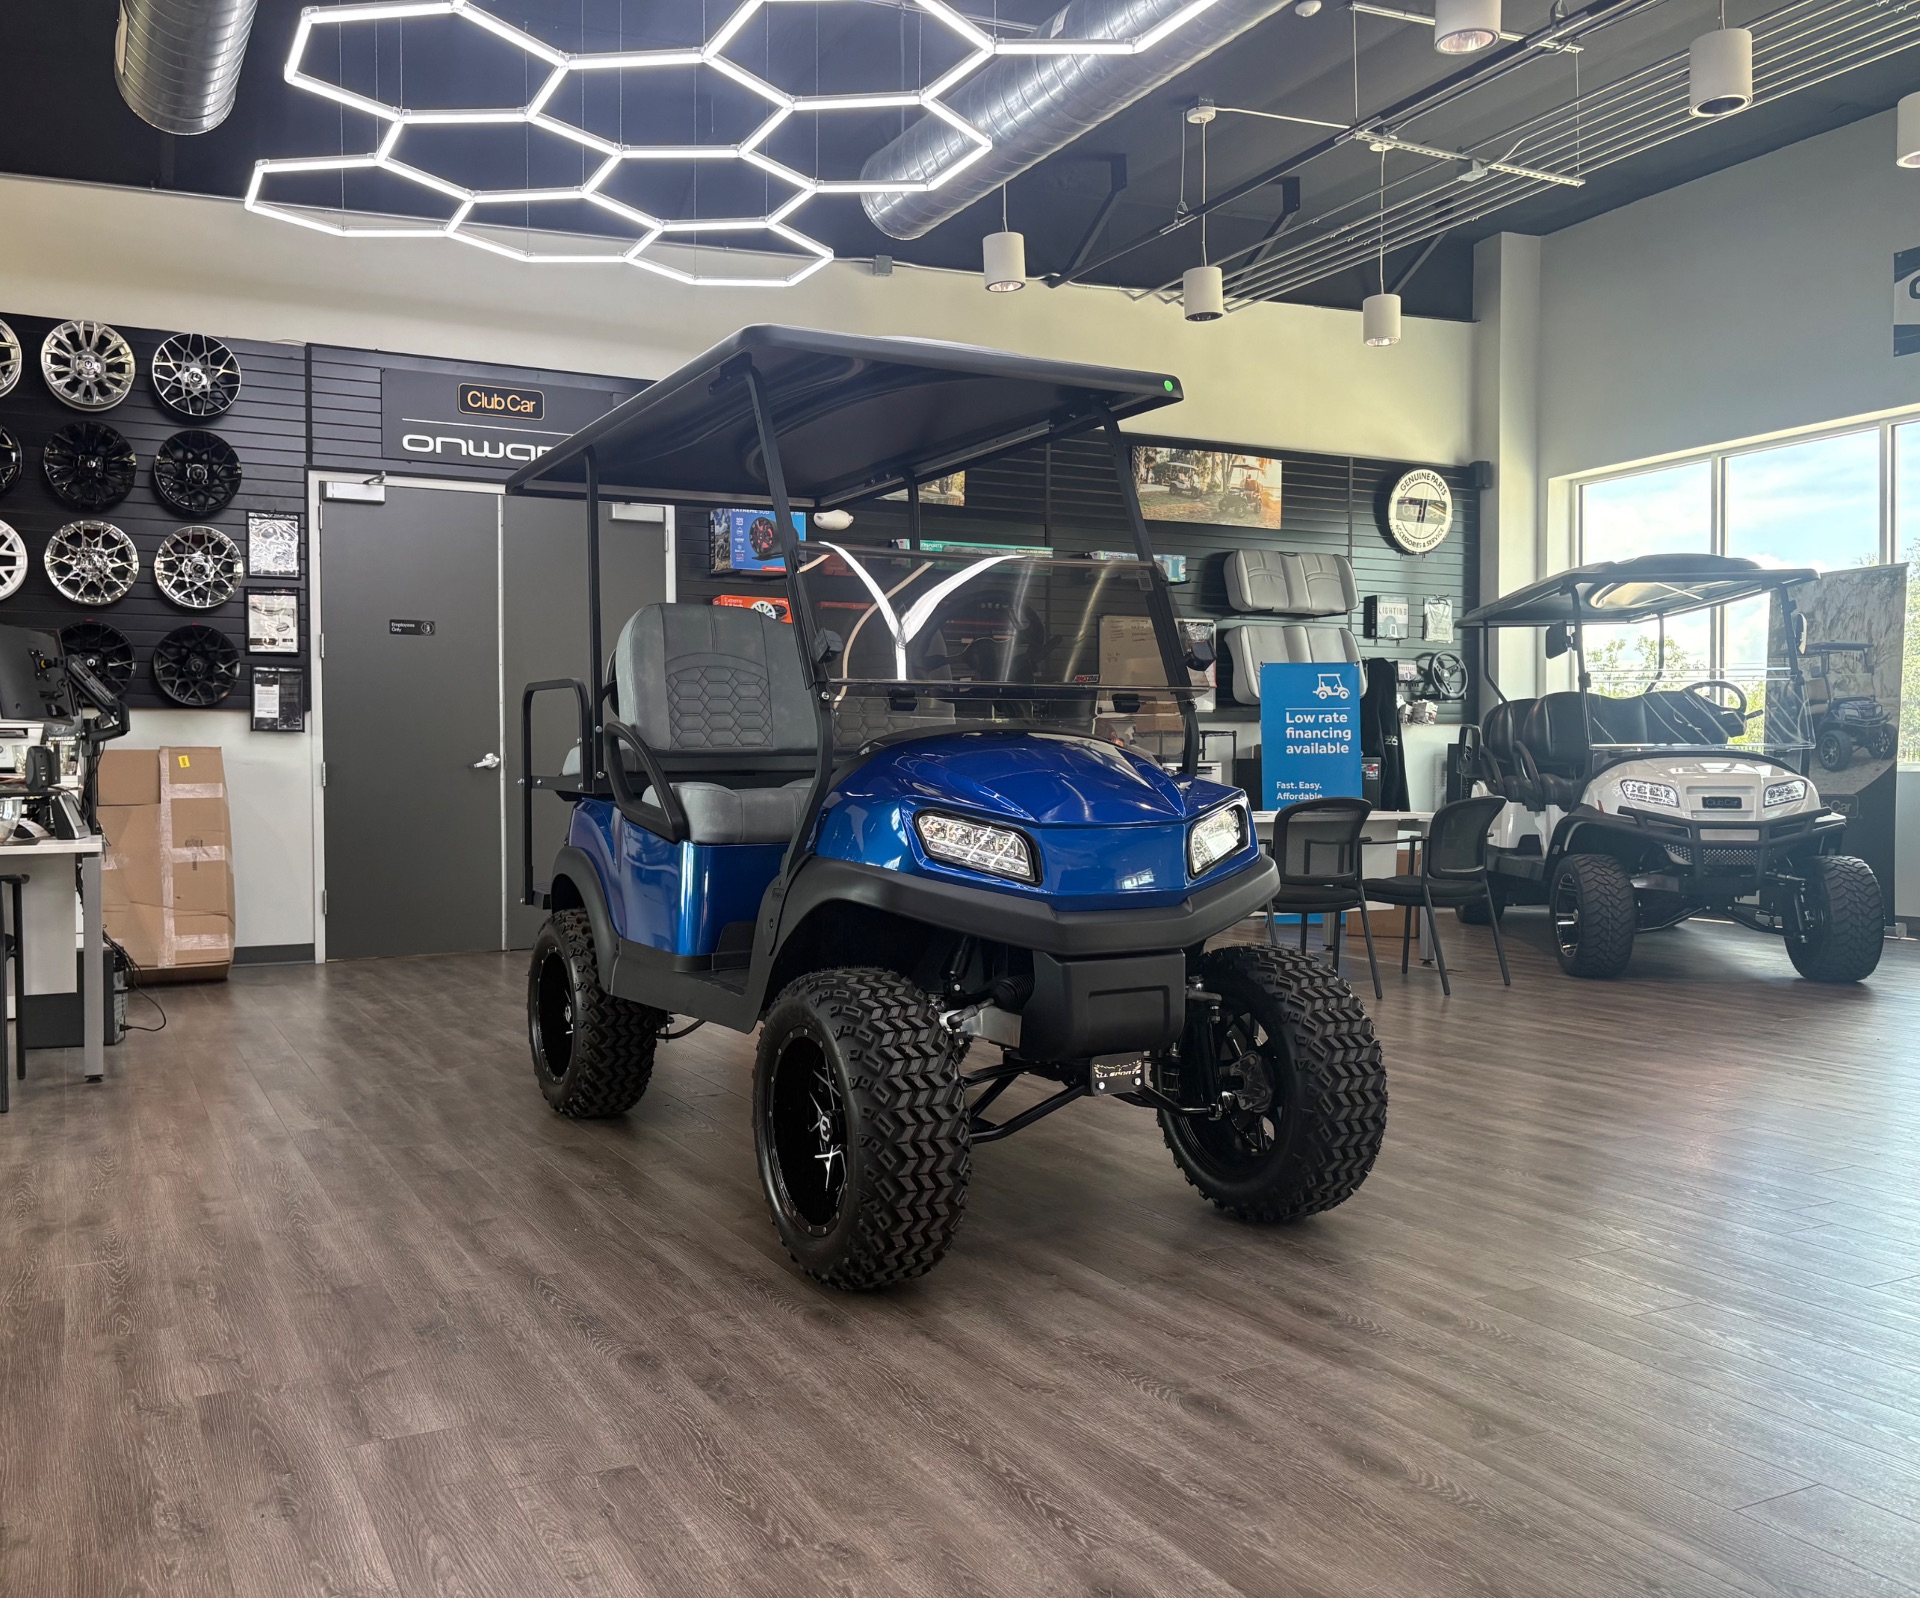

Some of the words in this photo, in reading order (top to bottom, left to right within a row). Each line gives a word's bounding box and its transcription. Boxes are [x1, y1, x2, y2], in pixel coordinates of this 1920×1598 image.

[467, 390, 506, 411] Club
[507, 394, 536, 413] Car
[402, 434, 554, 462] onwar
[1400, 472, 1431, 492] GENUINE
[1431, 475, 1447, 496] PARTS
[1426, 527, 1445, 547] SERVICE
[1379, 605, 1407, 616] LIGHTING
[1285, 712, 1315, 723] Low
[1318, 712, 1348, 723] rate
[1285, 727, 1351, 741] financing
[1286, 743, 1349, 754] available
[1276, 781, 1297, 789] Fast.
[1299, 781, 1322, 790] Easy.
[1830, 800, 1851, 812] Car
